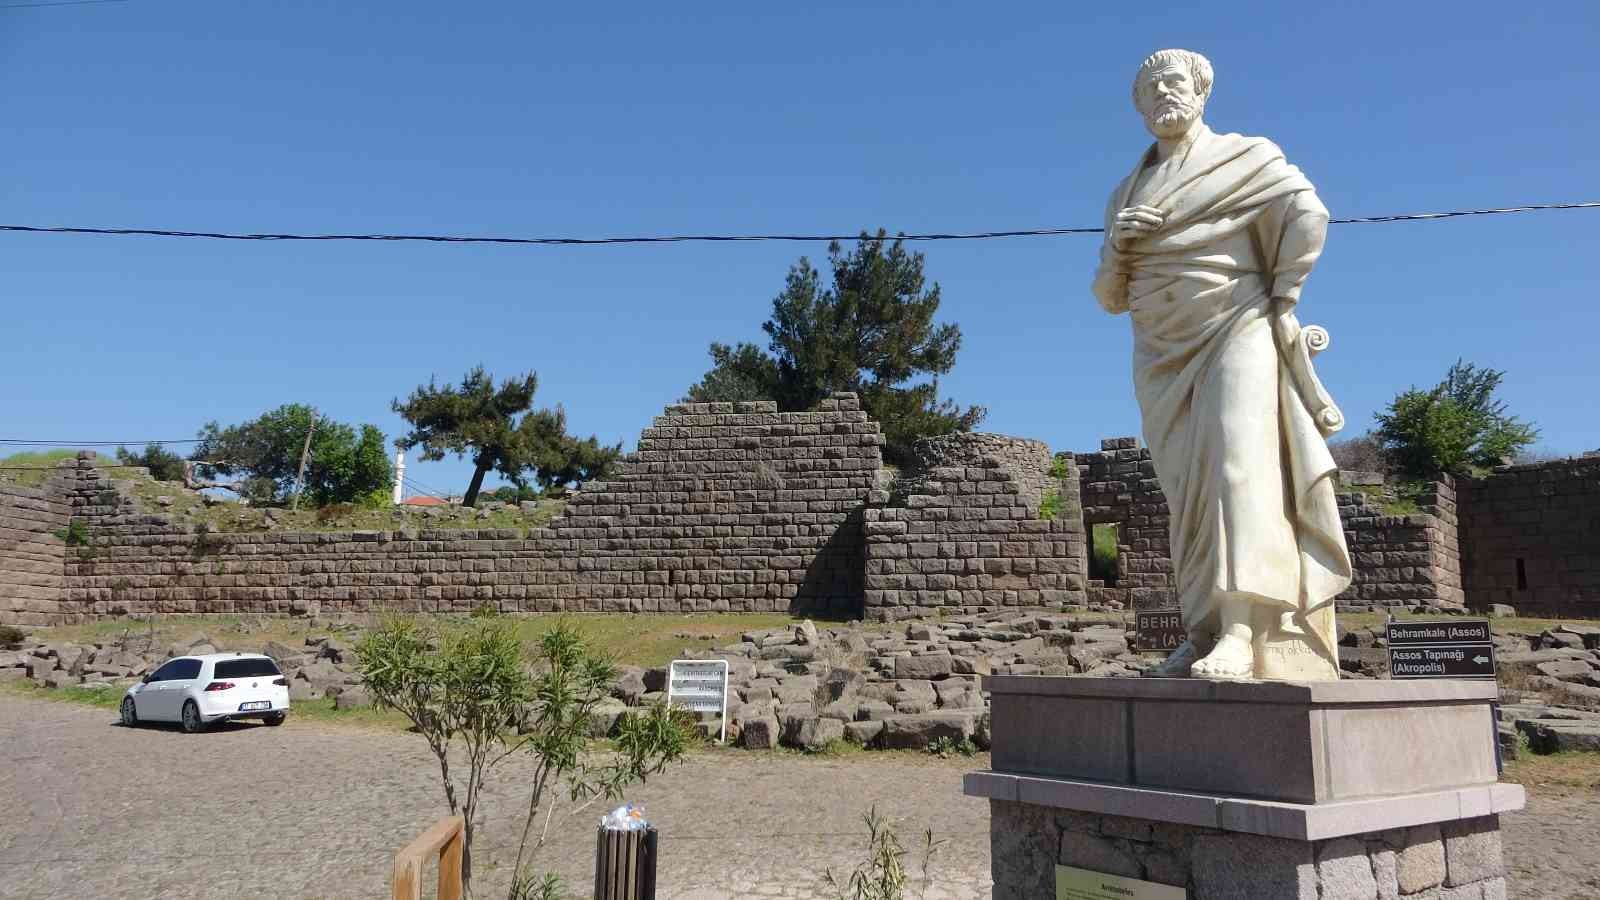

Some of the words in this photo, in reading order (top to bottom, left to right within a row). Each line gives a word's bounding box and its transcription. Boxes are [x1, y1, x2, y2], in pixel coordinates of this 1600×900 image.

[1390, 628, 1446, 639] Behramkale
[1448, 627, 1485, 639] (Assos)
[1392, 651, 1422, 660] Assos
[1424, 649, 1465, 661] Tapınağı
[1393, 663, 1446, 674] (Akropolis)
